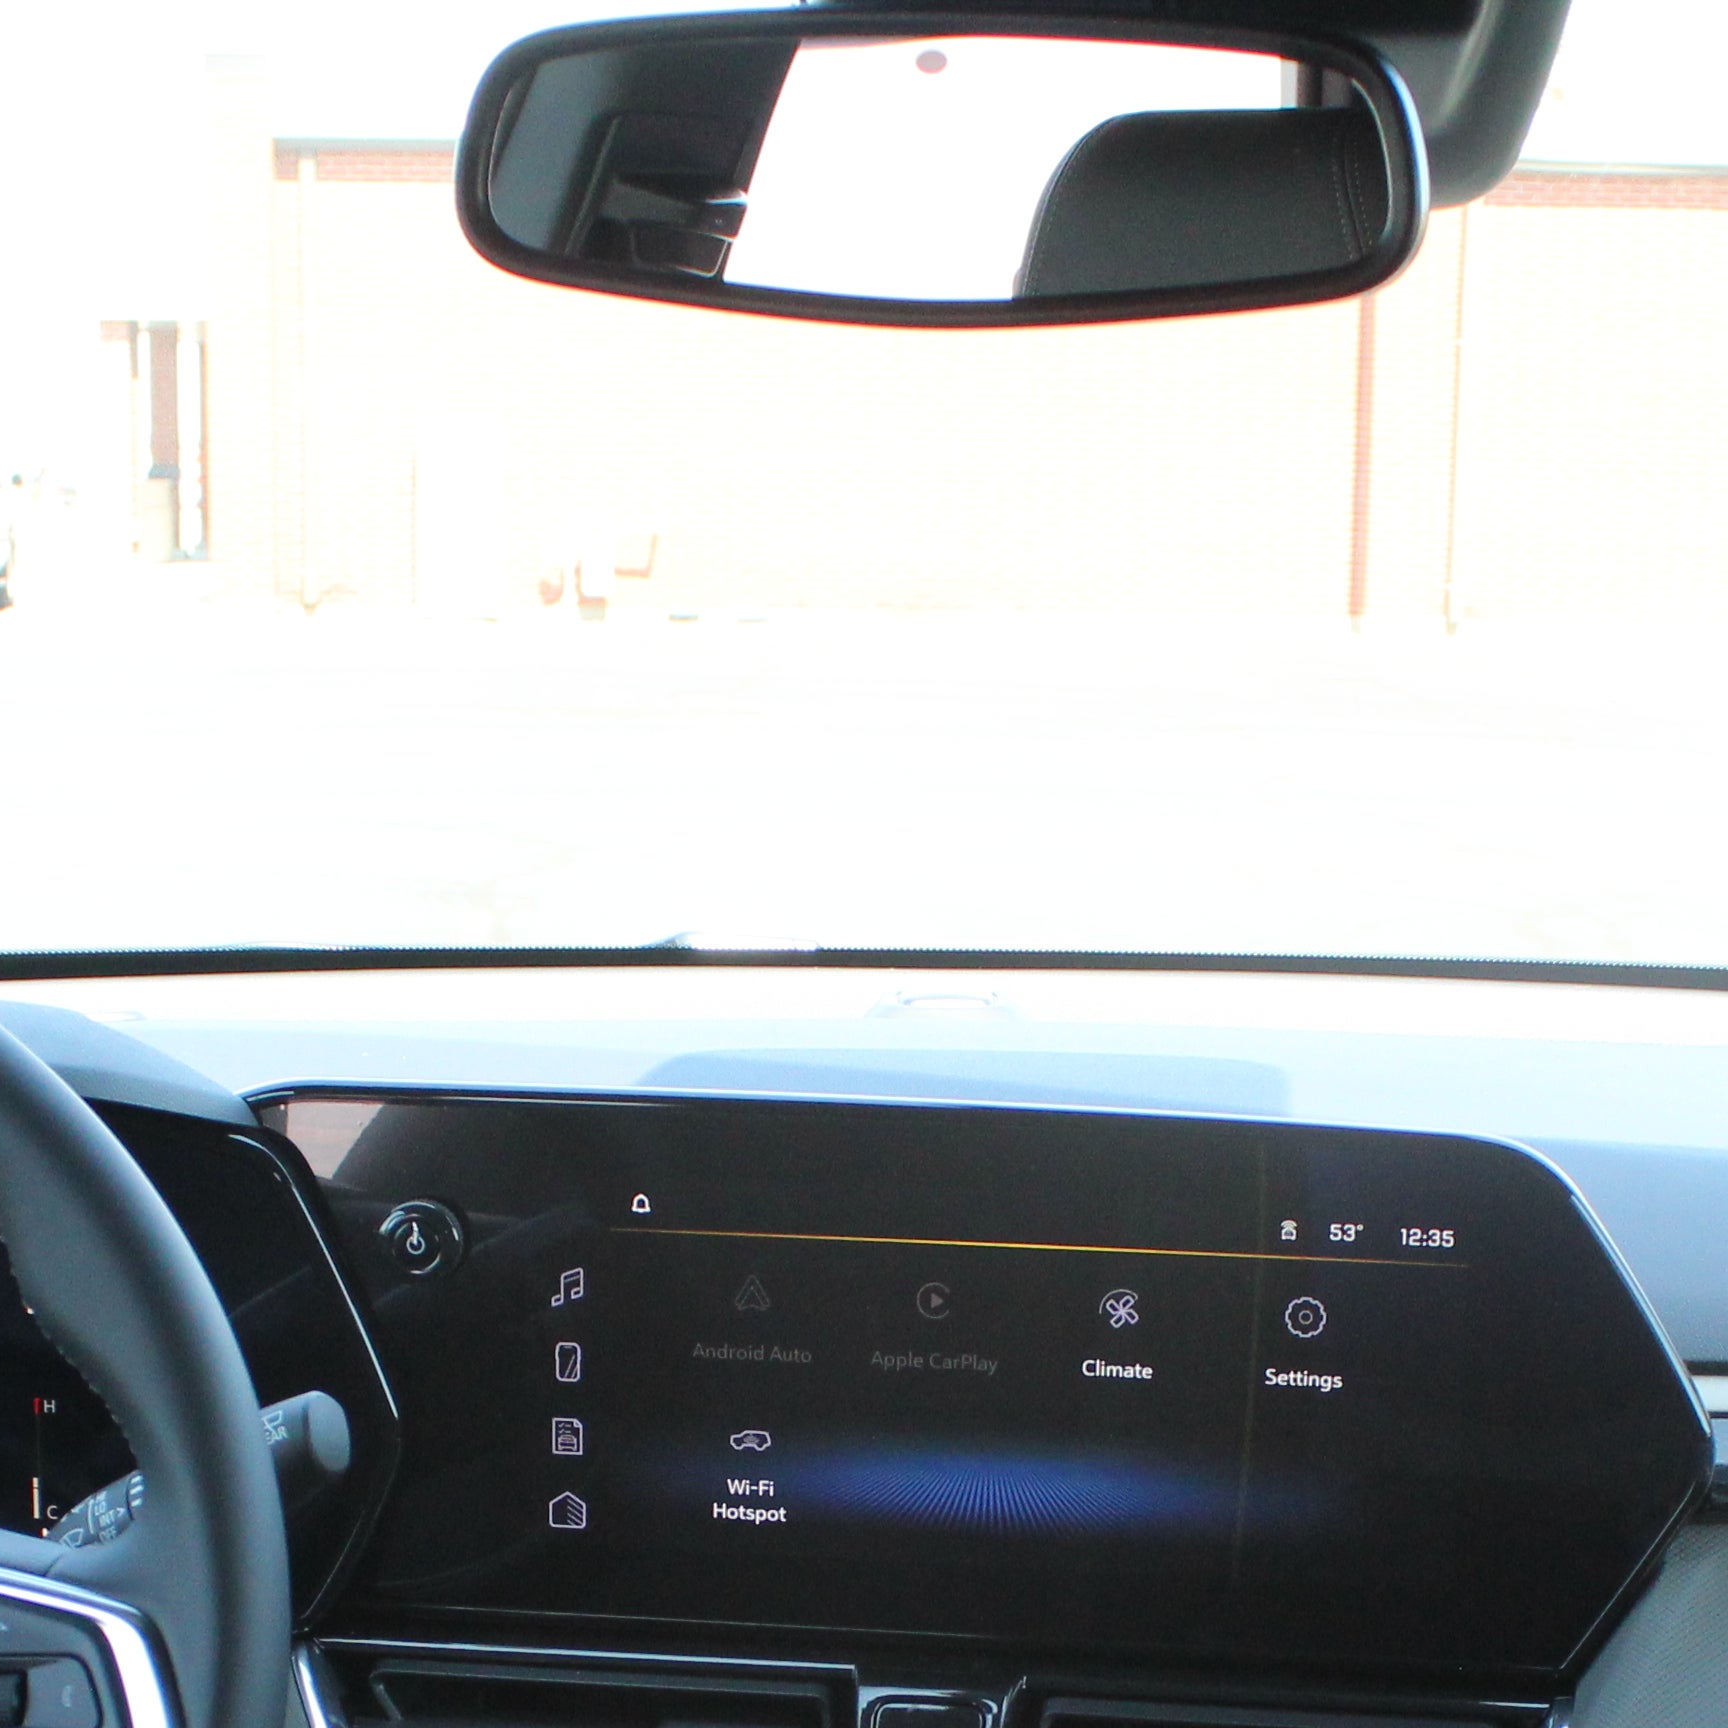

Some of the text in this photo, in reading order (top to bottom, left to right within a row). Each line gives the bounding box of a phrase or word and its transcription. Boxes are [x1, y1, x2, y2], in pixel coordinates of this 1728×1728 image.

[1401, 1228, 1454, 1247] 12:35
[692, 1342, 812, 1363] Android Auto
[871, 1350, 998, 1375] Apple CarPlay
[1081, 1359, 1153, 1379] Climate
[1265, 1368, 1343, 1392] Settings
[43, 1400, 56, 1413] H
[727, 1479, 774, 1496] Wi-Fi
[47, 1505, 58, 1519] C
[713, 1502, 786, 1525] Hotspot
